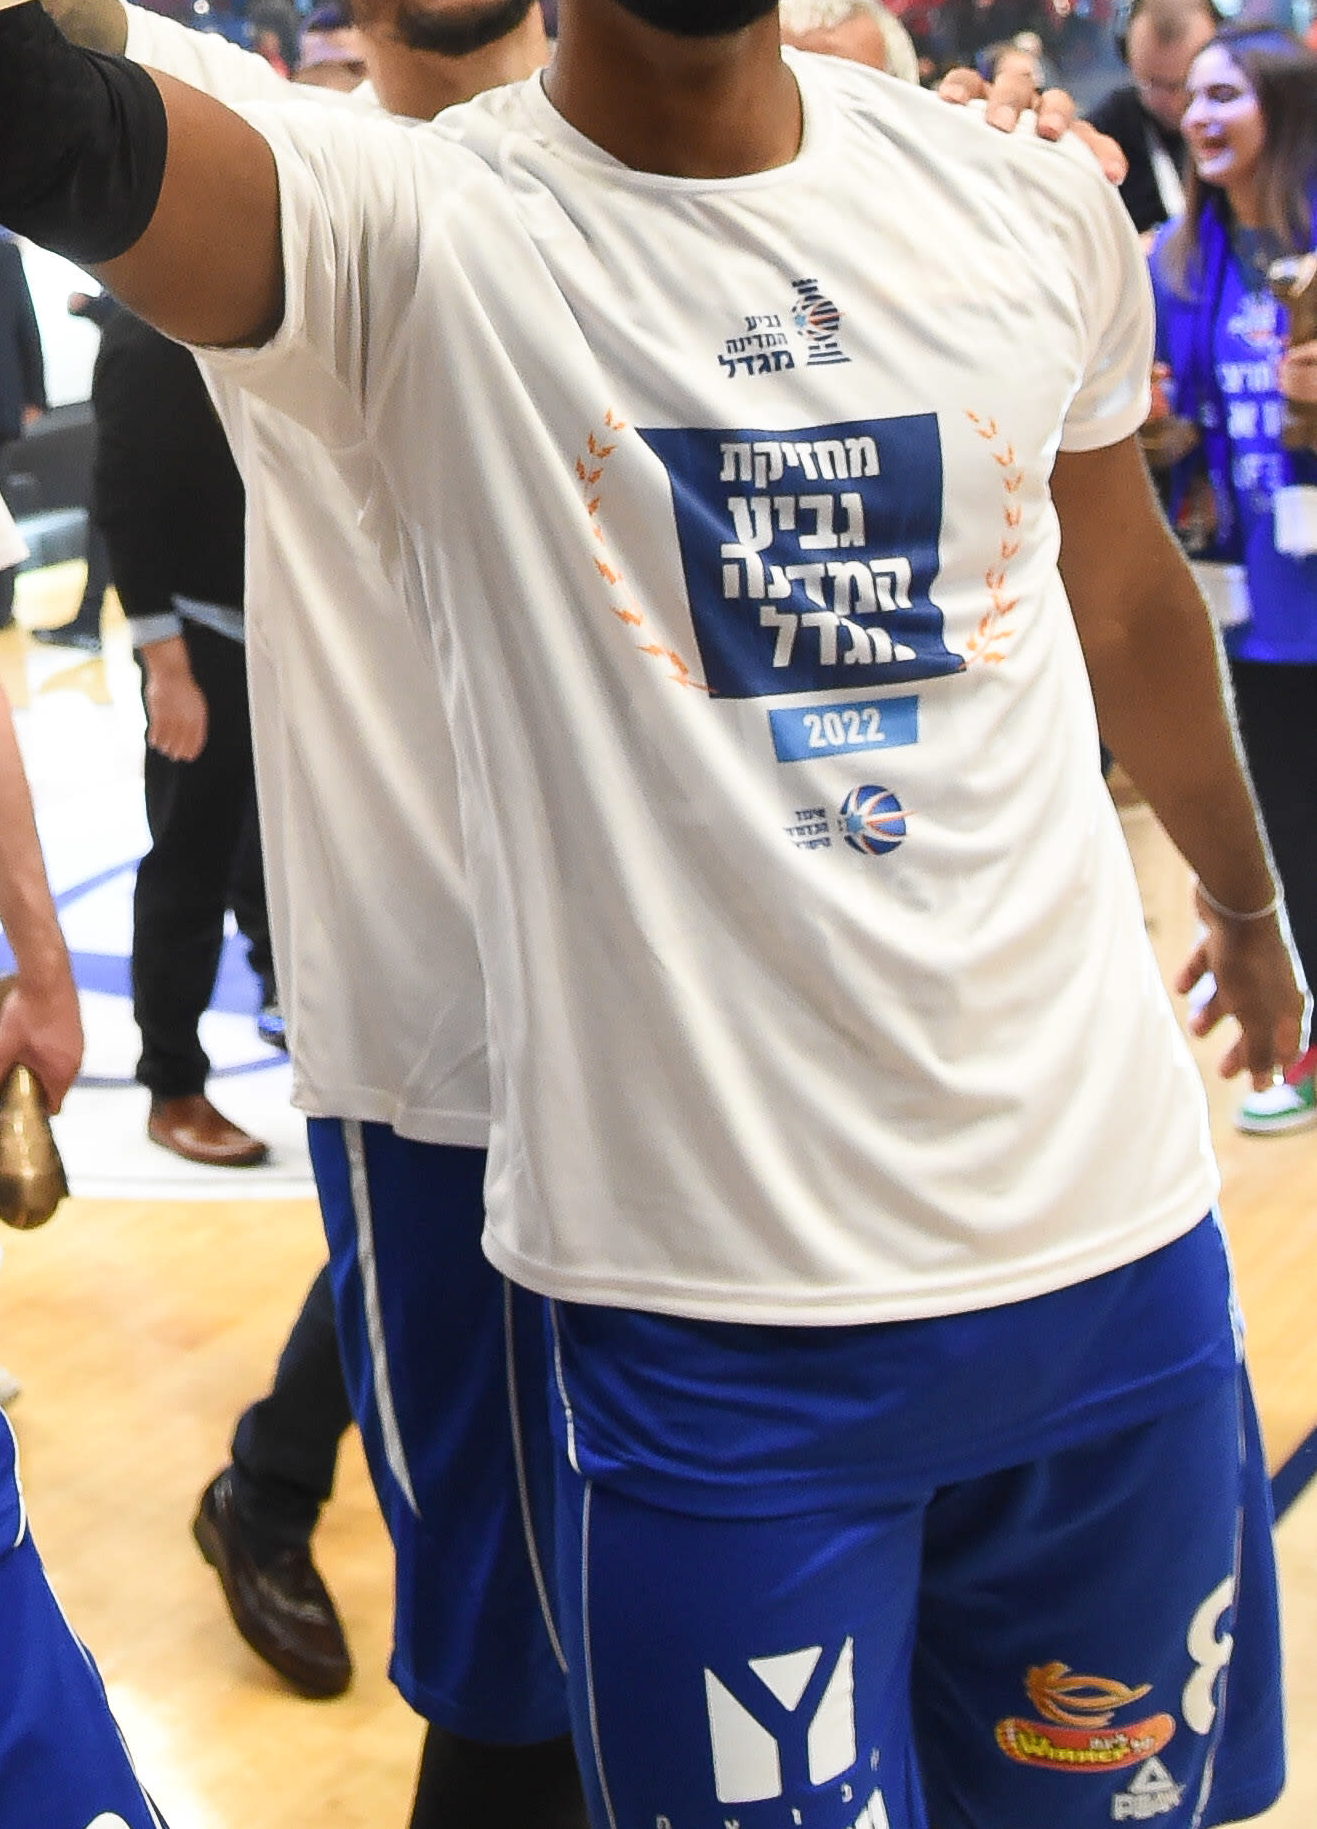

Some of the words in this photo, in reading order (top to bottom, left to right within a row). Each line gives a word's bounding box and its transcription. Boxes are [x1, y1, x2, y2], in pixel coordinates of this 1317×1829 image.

[725, 332, 788, 354] המדינה
[745, 314, 781, 331] גביע
[718, 350, 795, 378] מגדל
[719, 436, 880, 489] מחזיקת
[727, 492, 866, 551] גביע
[720, 544, 913, 616] המדנה
[802, 707, 886, 748] 2022
